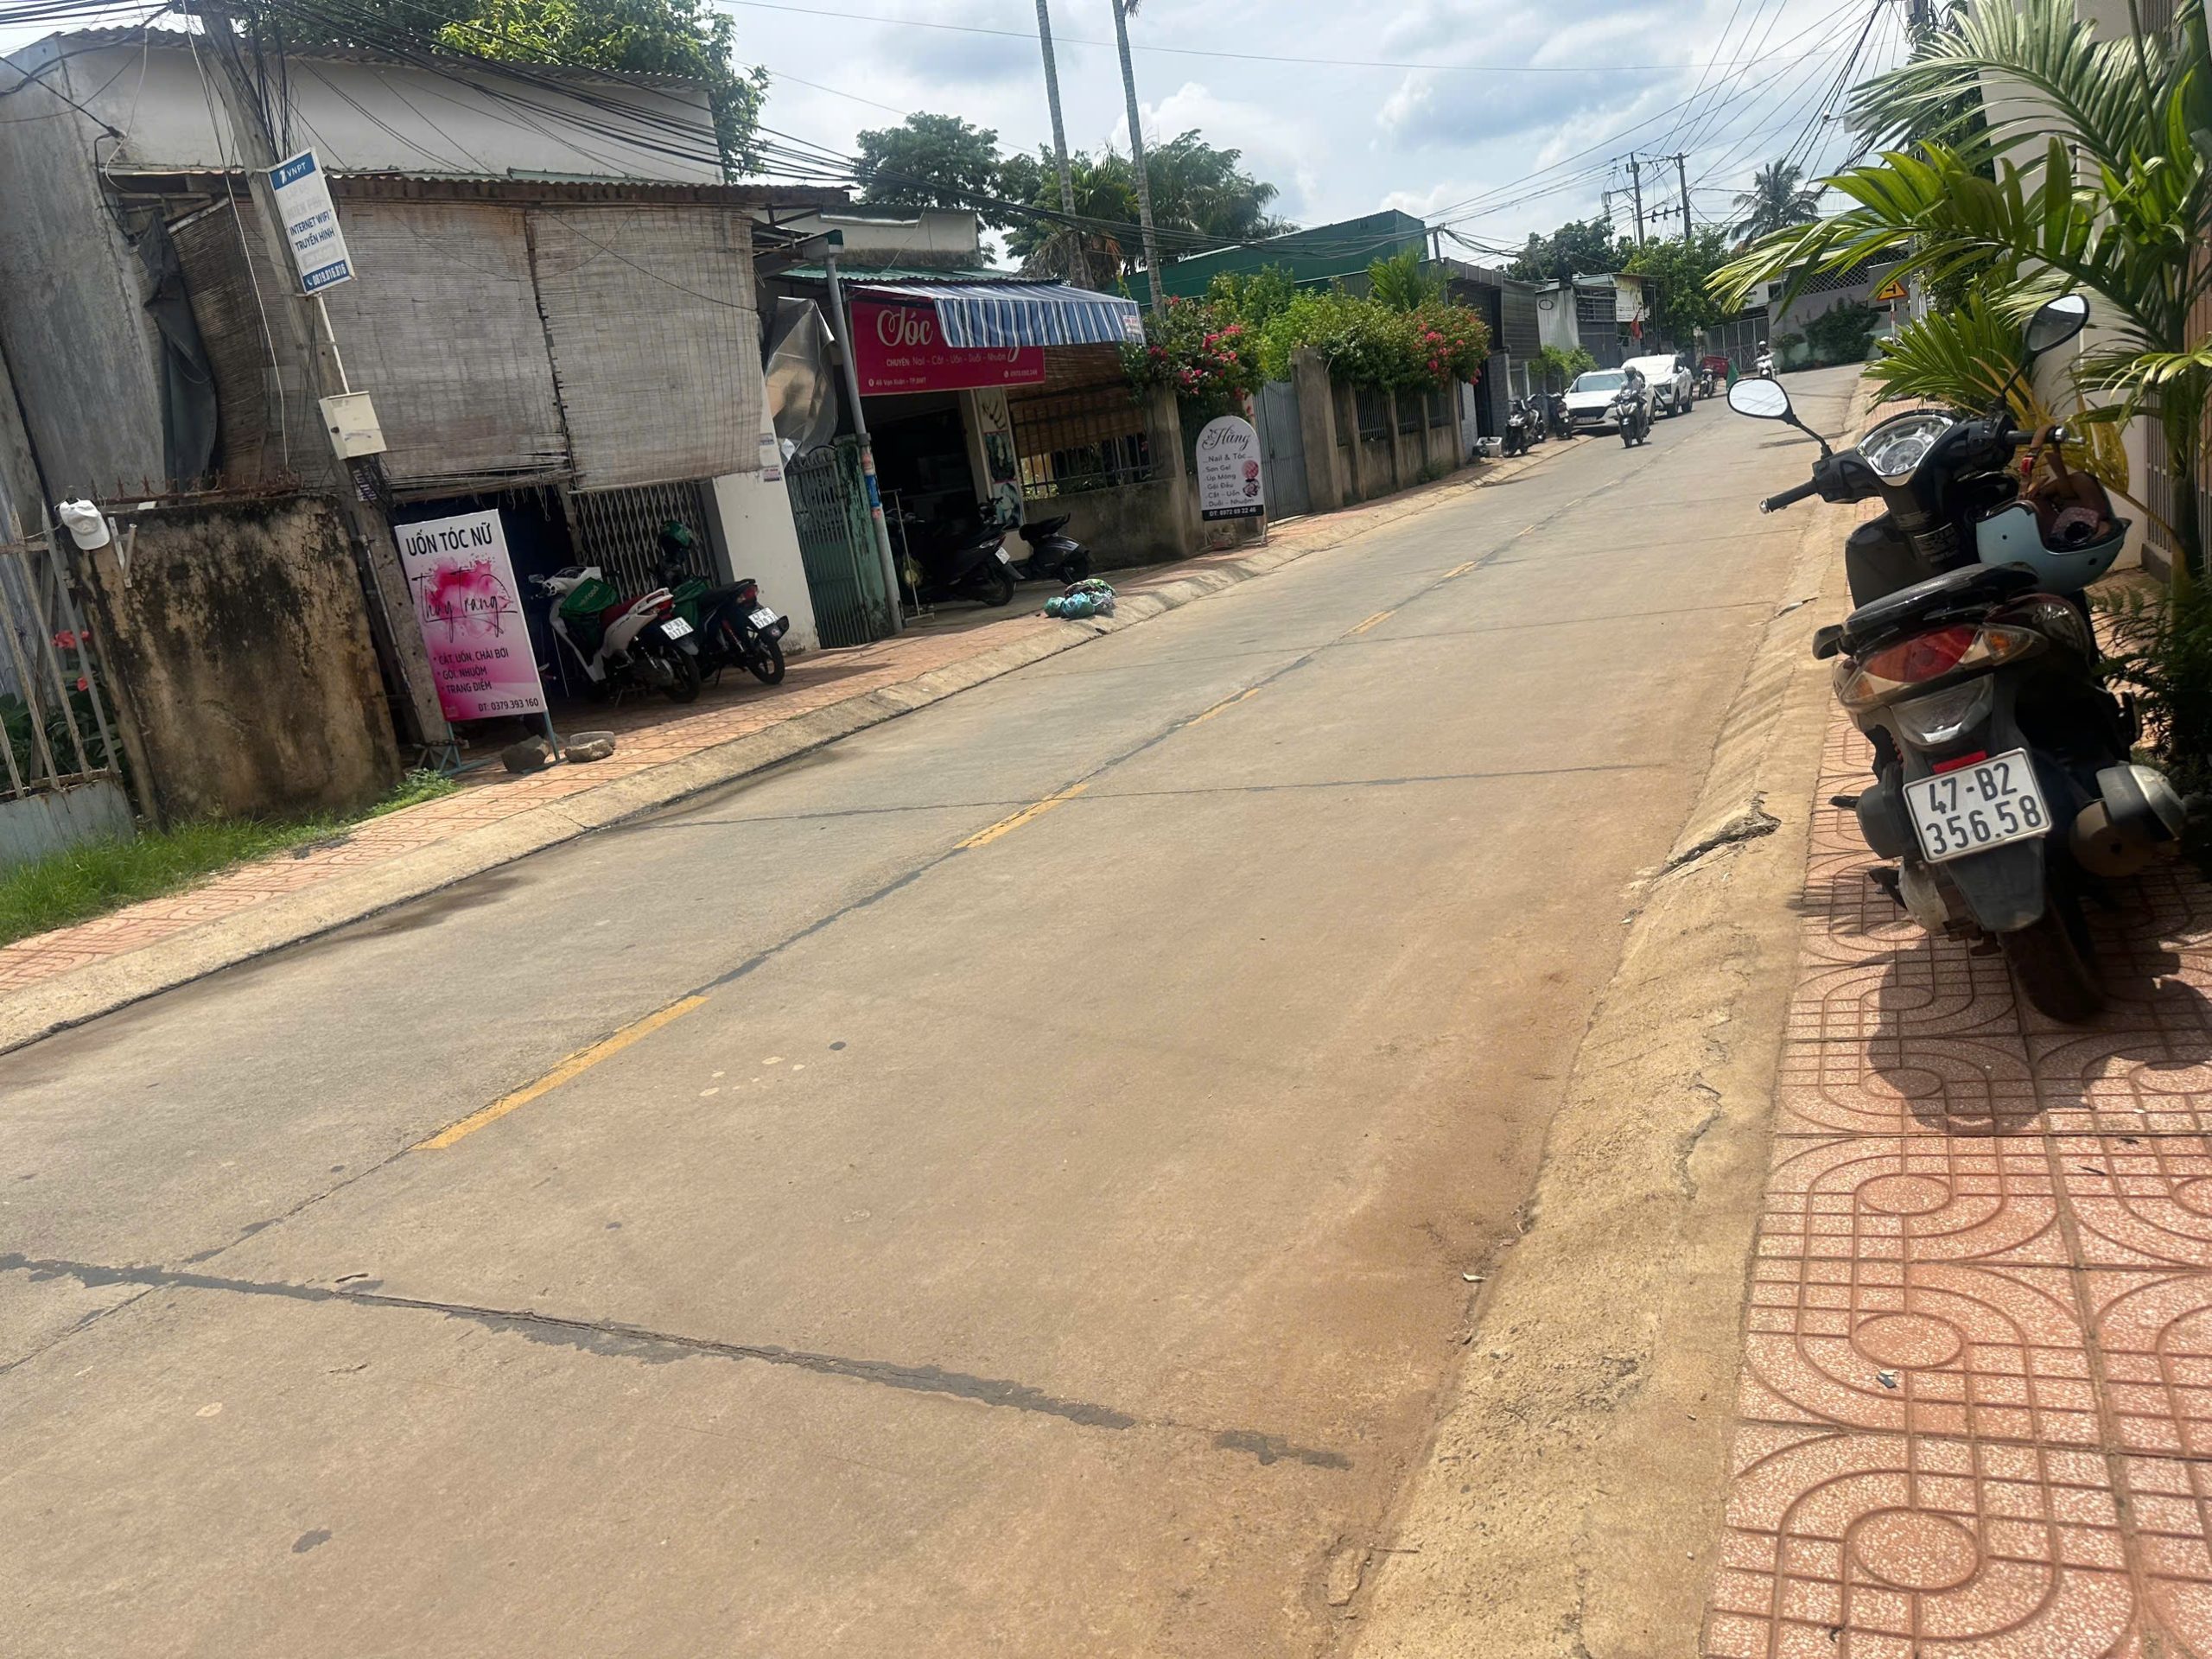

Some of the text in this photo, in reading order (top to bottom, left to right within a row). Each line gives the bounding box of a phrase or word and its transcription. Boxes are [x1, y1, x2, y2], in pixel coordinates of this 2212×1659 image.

[287, 162, 307, 178] VNPT
[289, 216, 316, 236] INTERNET
[319, 227, 335, 243] HÌNH
[876, 306, 933, 346] Tóc
[405, 522, 493, 556] UỐN TÓC NỮ
[446, 681, 472, 694] TRANG
[525, 697, 539, 707] 160
[1929, 762, 2018, 815] 47-B2
[1925, 795, 2042, 855] 356.58
